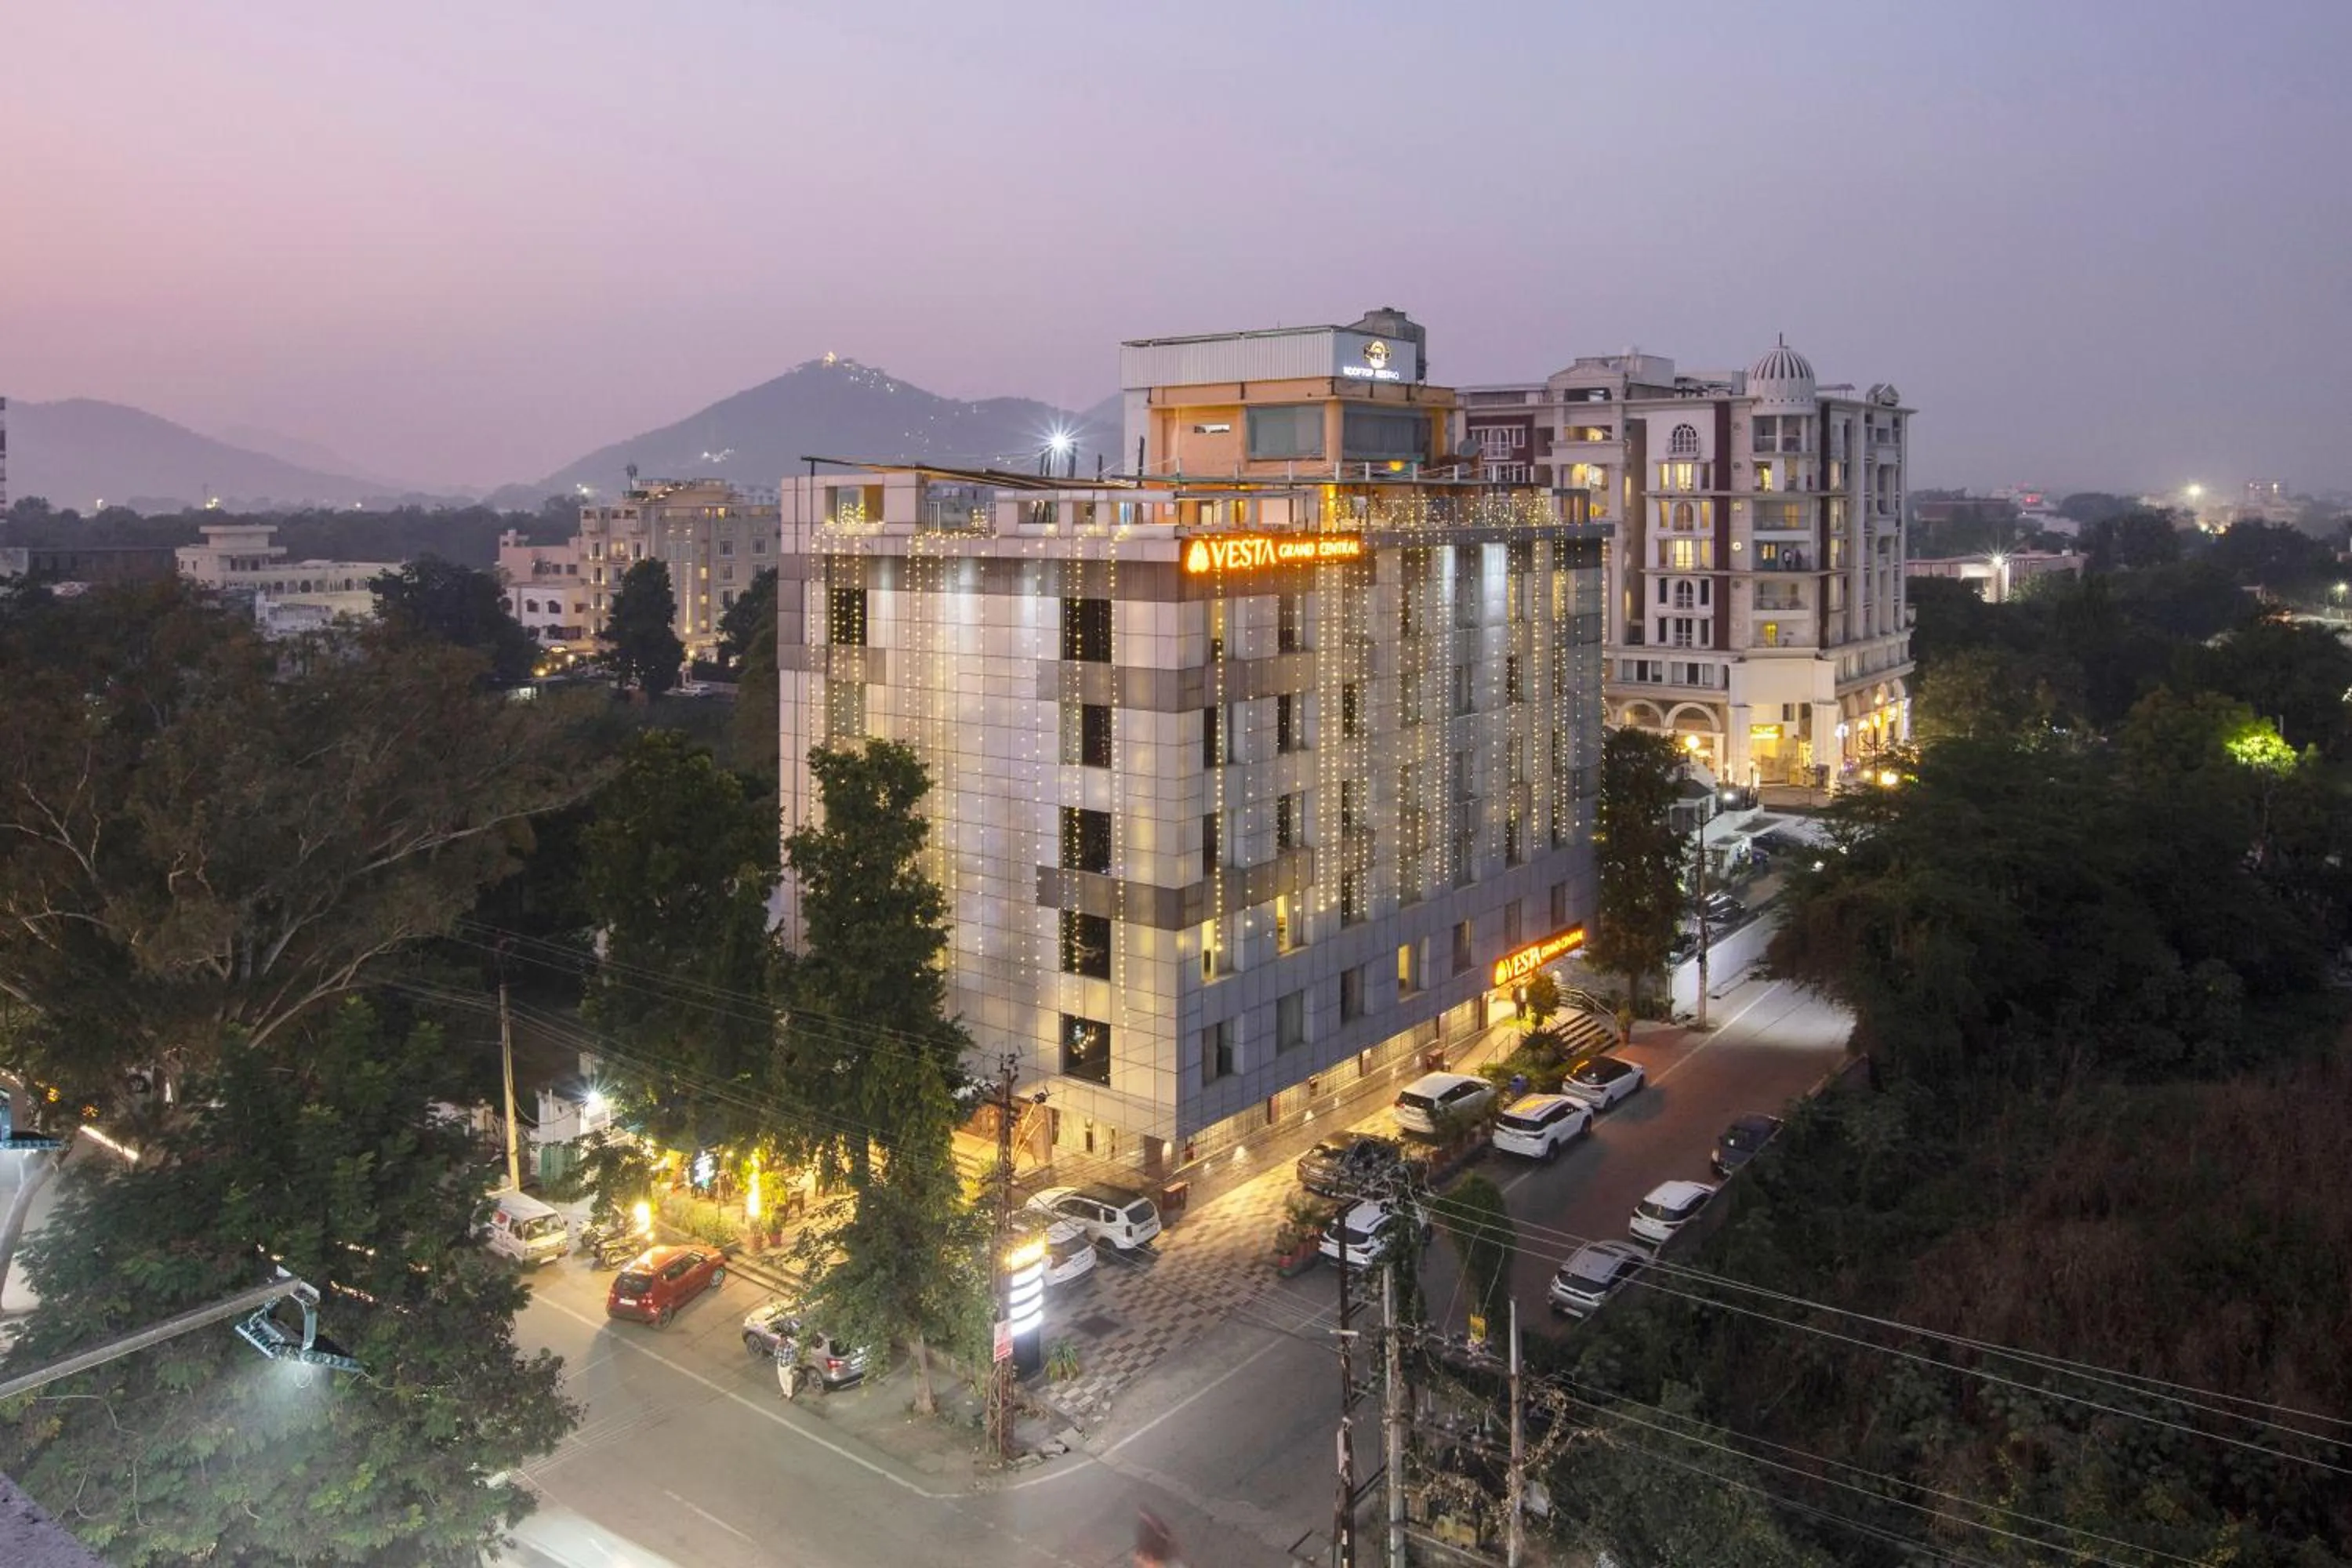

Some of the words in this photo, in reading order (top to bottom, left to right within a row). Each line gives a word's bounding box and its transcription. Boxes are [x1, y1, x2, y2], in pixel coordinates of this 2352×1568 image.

[1211, 539, 1276, 568] VESTA
[1279, 543, 1315, 557] GRAND
[1319, 541, 1359, 555] CENTRAL
[1505, 946, 1541, 978] VESTA
